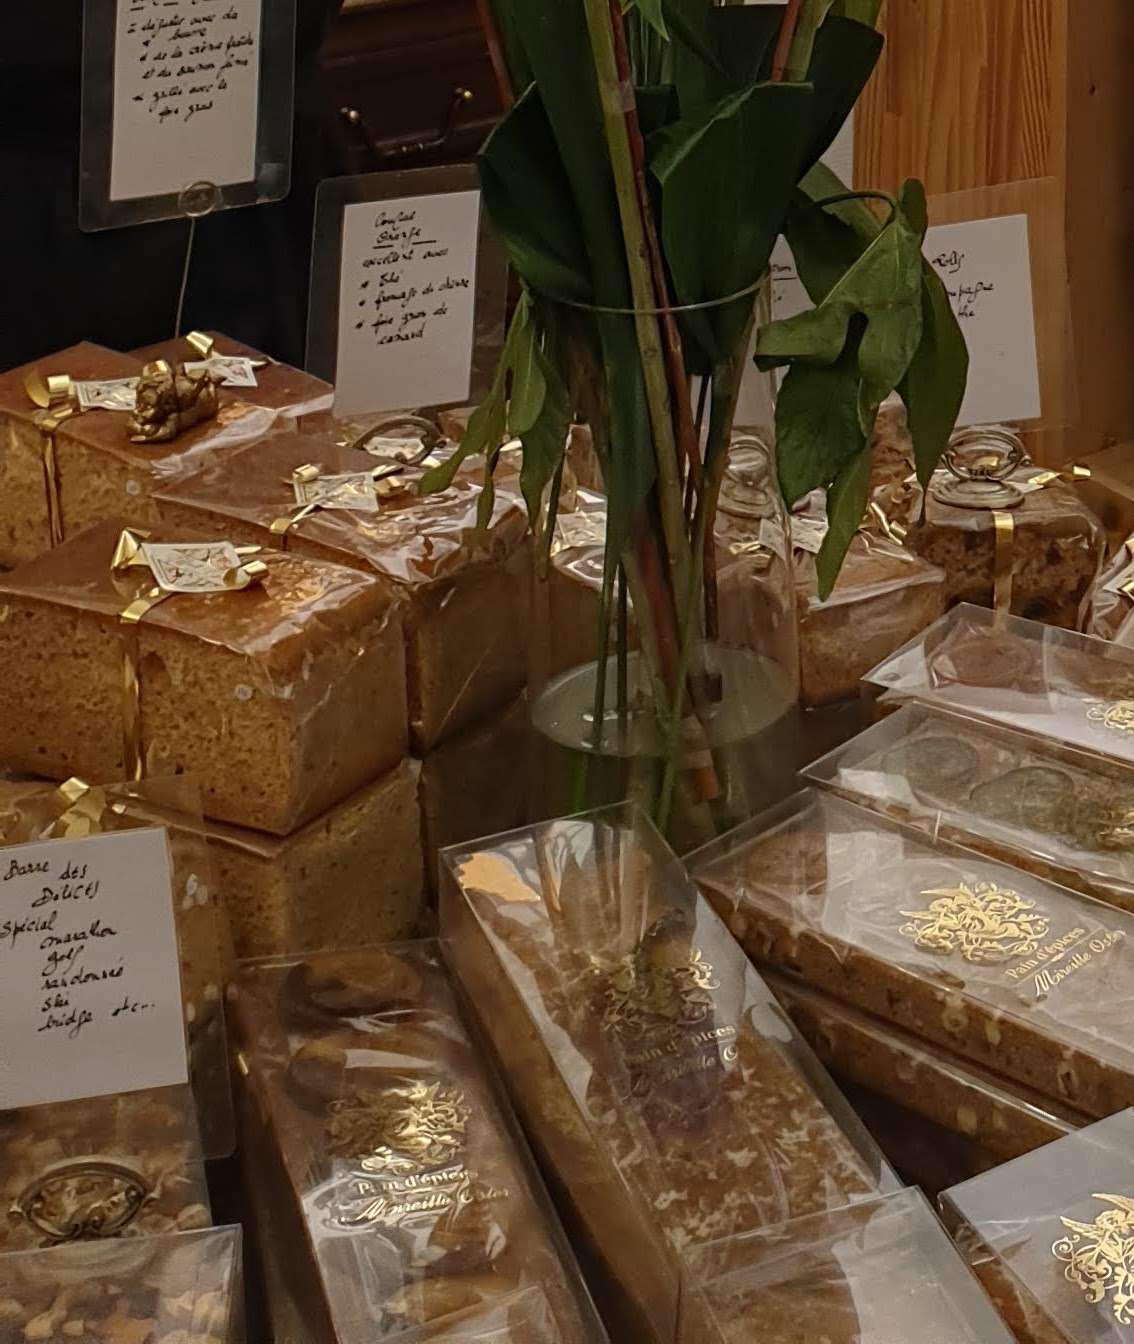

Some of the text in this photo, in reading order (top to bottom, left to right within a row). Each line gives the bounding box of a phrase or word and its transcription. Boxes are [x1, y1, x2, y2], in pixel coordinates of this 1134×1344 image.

[1005, 928, 1085, 978] Pain d'épices
[1034, 951, 1092, 998] Mireille
